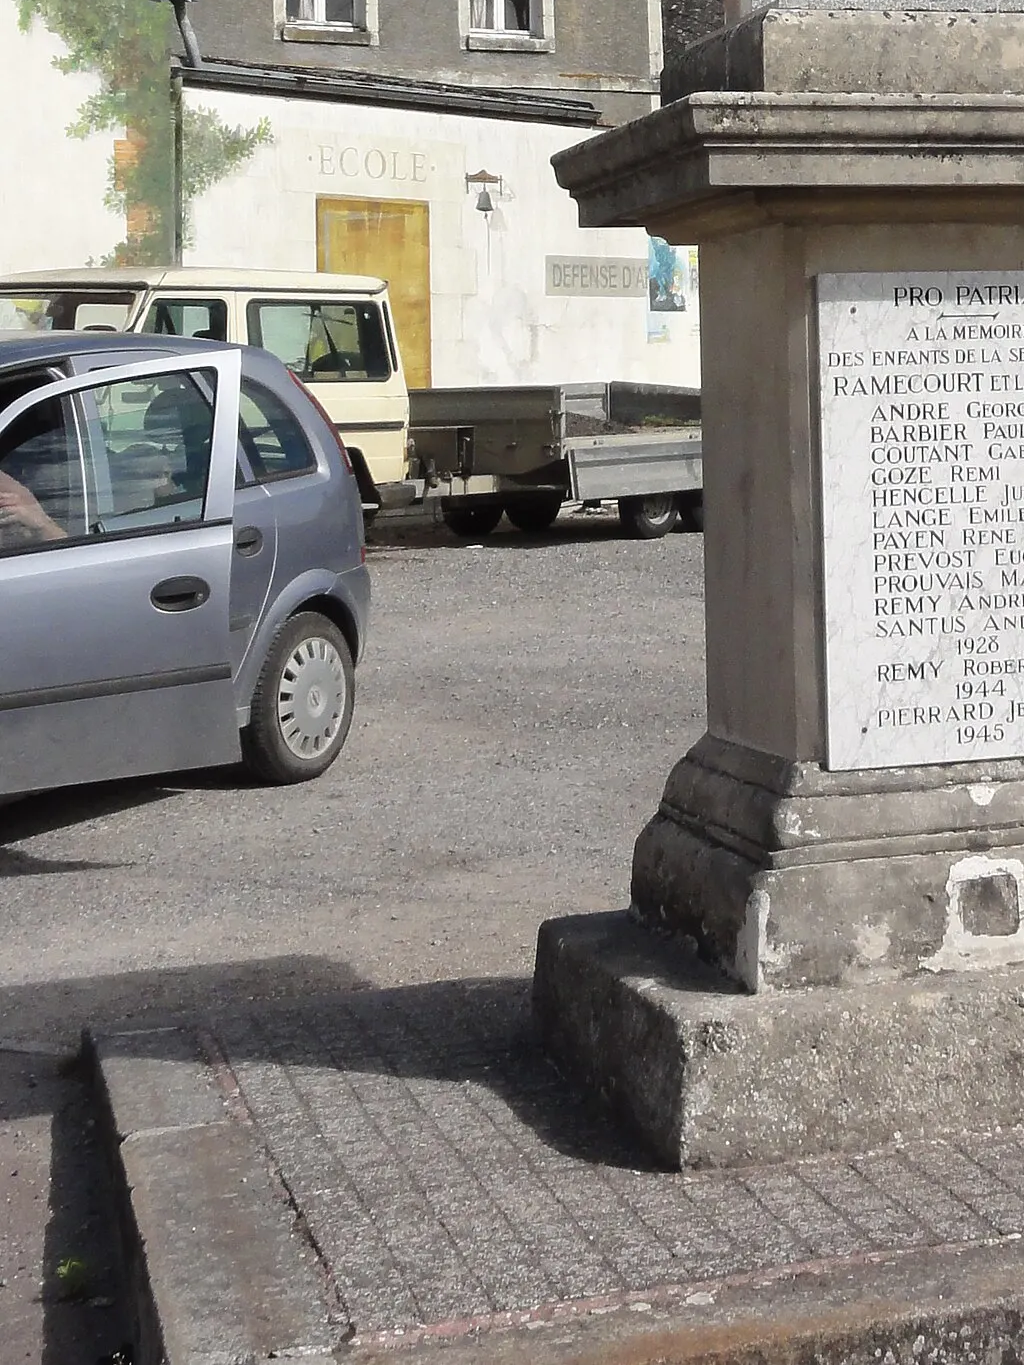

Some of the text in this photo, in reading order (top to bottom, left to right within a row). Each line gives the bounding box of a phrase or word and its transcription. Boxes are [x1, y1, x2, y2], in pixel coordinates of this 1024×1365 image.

[318, 144, 428, 182] ECOLE
[552, 263, 617, 288] DEFENSE
[893, 286, 943, 308] PRO
[906, 327, 920, 341] A
[925, 326, 948, 342] LA
[828, 351, 865, 368] DES
[872, 349, 950, 367] ENFANTS
[955, 348, 977, 364] DE
[981, 348, 1002, 364] LA
[833, 372, 985, 397] RAMECOURT
[990, 374, 1011, 392] ET
[871, 402, 950, 423] ANDRE
[870, 422, 968, 444] BARBIER
[871, 443, 974, 465] COUTANT
[871, 464, 1001, 486] GOZE REMI
[872, 485, 988, 508] HENCELLE
[872, 507, 952, 530] LANGE
[873, 528, 1017, 551] PAYEN RENE
[874, 549, 976, 573] PREVOST
[874, 570, 984, 595] PROUVAIS
[874, 594, 942, 617] REMY
[875, 615, 966, 639] SANTUS
[957, 635, 1000, 656] 1928
[877, 659, 945, 683] REMY
[955, 679, 1007, 700] 1944
[878, 701, 994, 728] PIERRARD
[956, 723, 1005, 745] 1945
